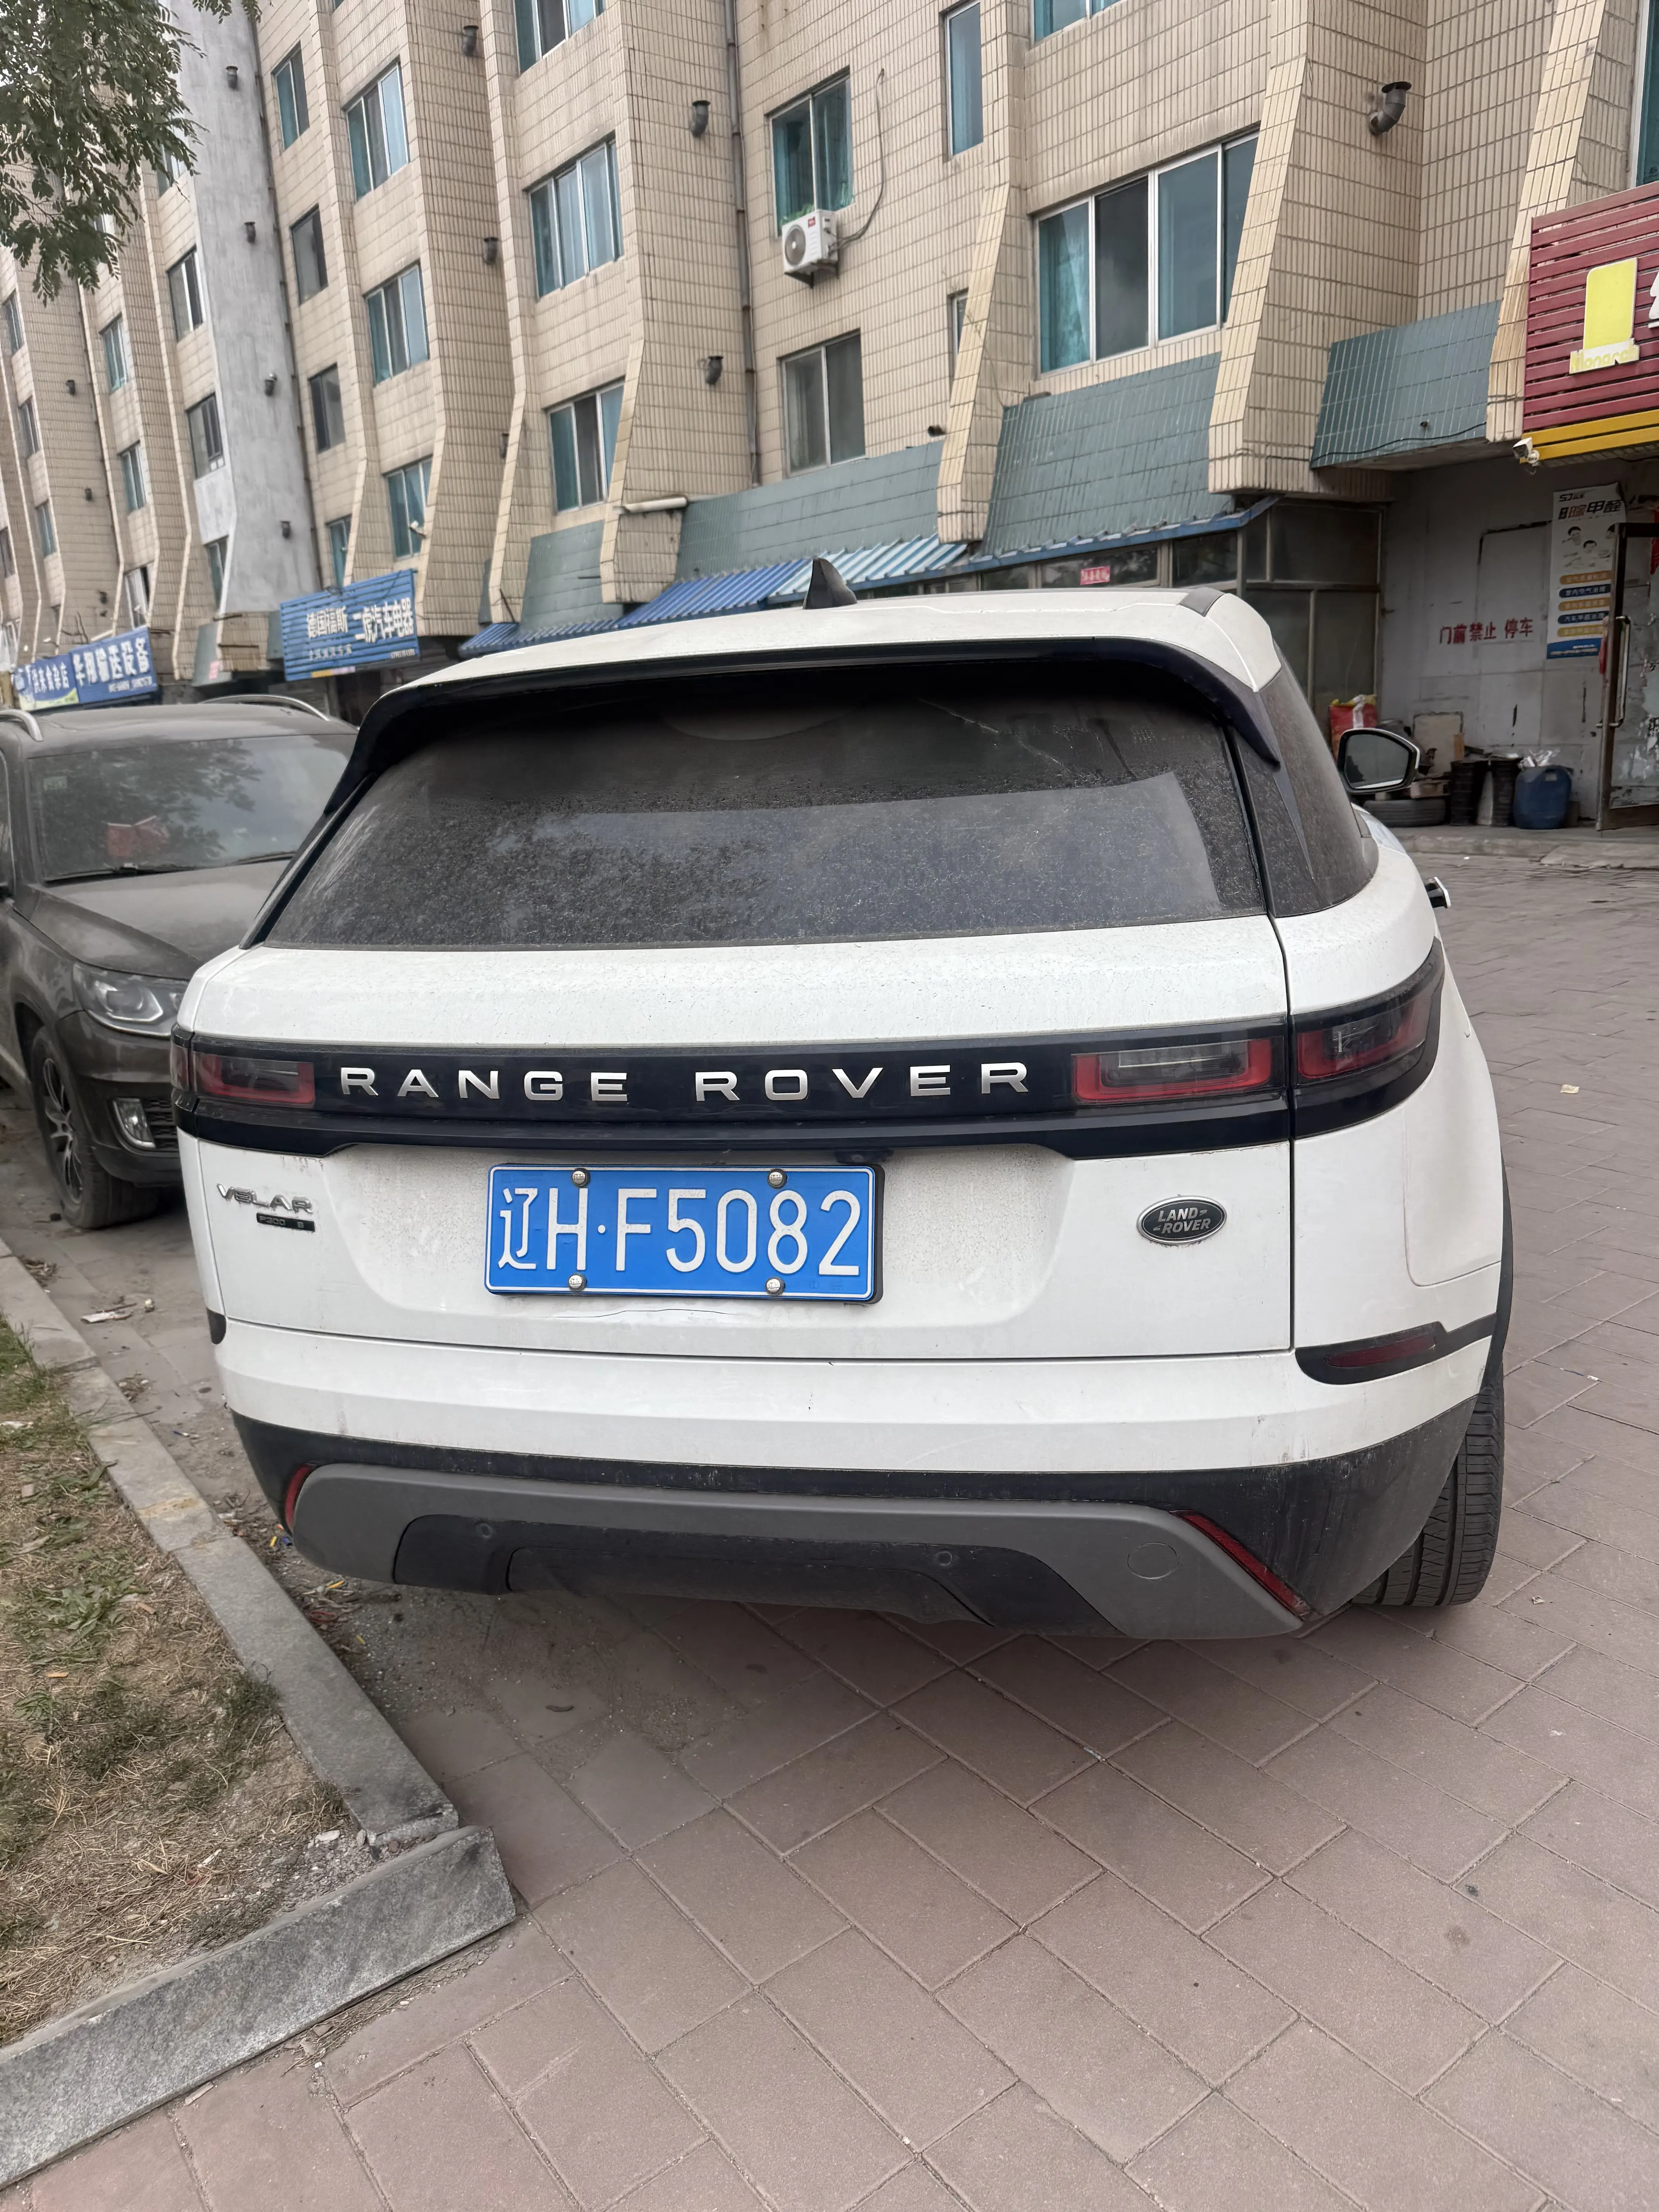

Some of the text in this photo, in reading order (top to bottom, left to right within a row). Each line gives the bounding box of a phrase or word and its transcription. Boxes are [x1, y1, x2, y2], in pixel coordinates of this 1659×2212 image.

[307, 597, 414, 643] 德国福斯 二虎汽车电器
[340, 1062, 1029, 1101] RANGE ROVER
[216, 1183, 313, 1214] VELAR
[1158, 1207, 1198, 1222] LAND
[498, 1188, 861, 1276] 辽H·F5082
[1161, 1218, 1211, 1234] ROVER
